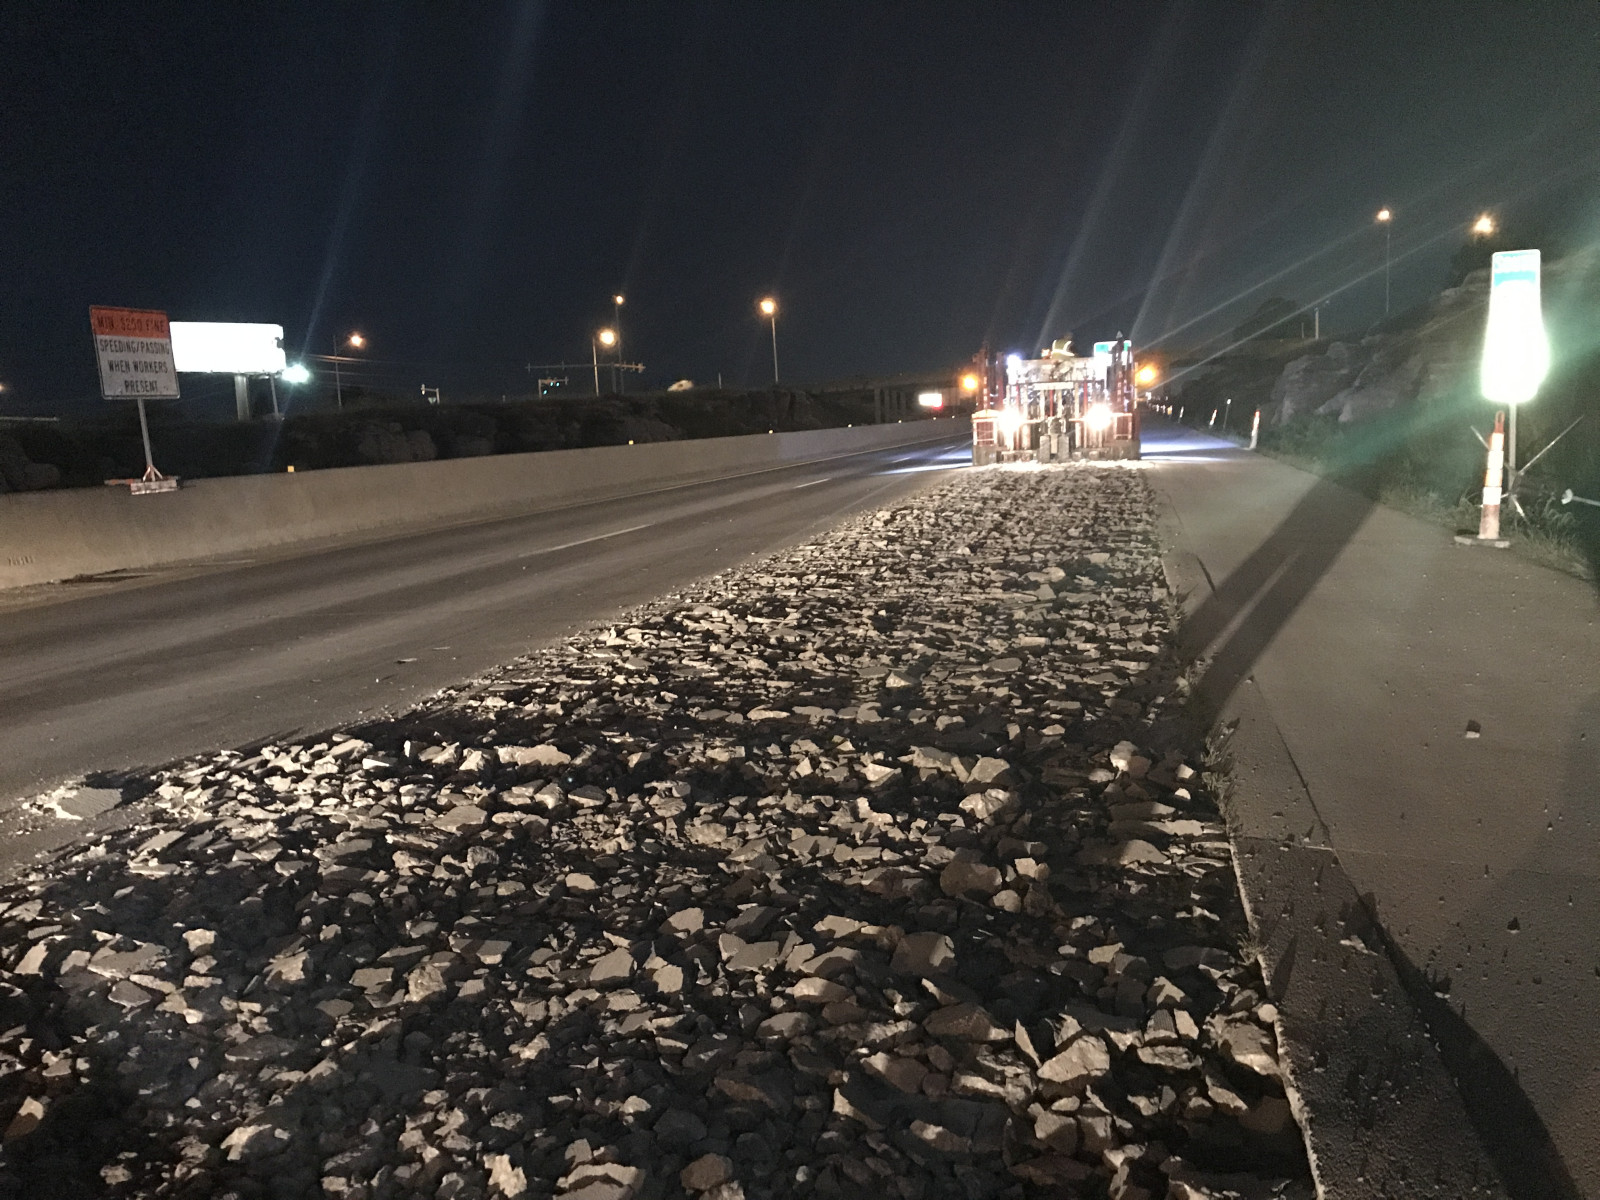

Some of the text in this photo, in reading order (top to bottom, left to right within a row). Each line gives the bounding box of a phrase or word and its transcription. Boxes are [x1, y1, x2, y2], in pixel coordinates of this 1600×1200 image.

[145, 318, 165, 333] FINE
[100, 339, 170, 355] SPEEDING/PASSING
[108, 360, 168, 374] WHEN WORKERS
[124, 380, 158, 393] PRESENT
